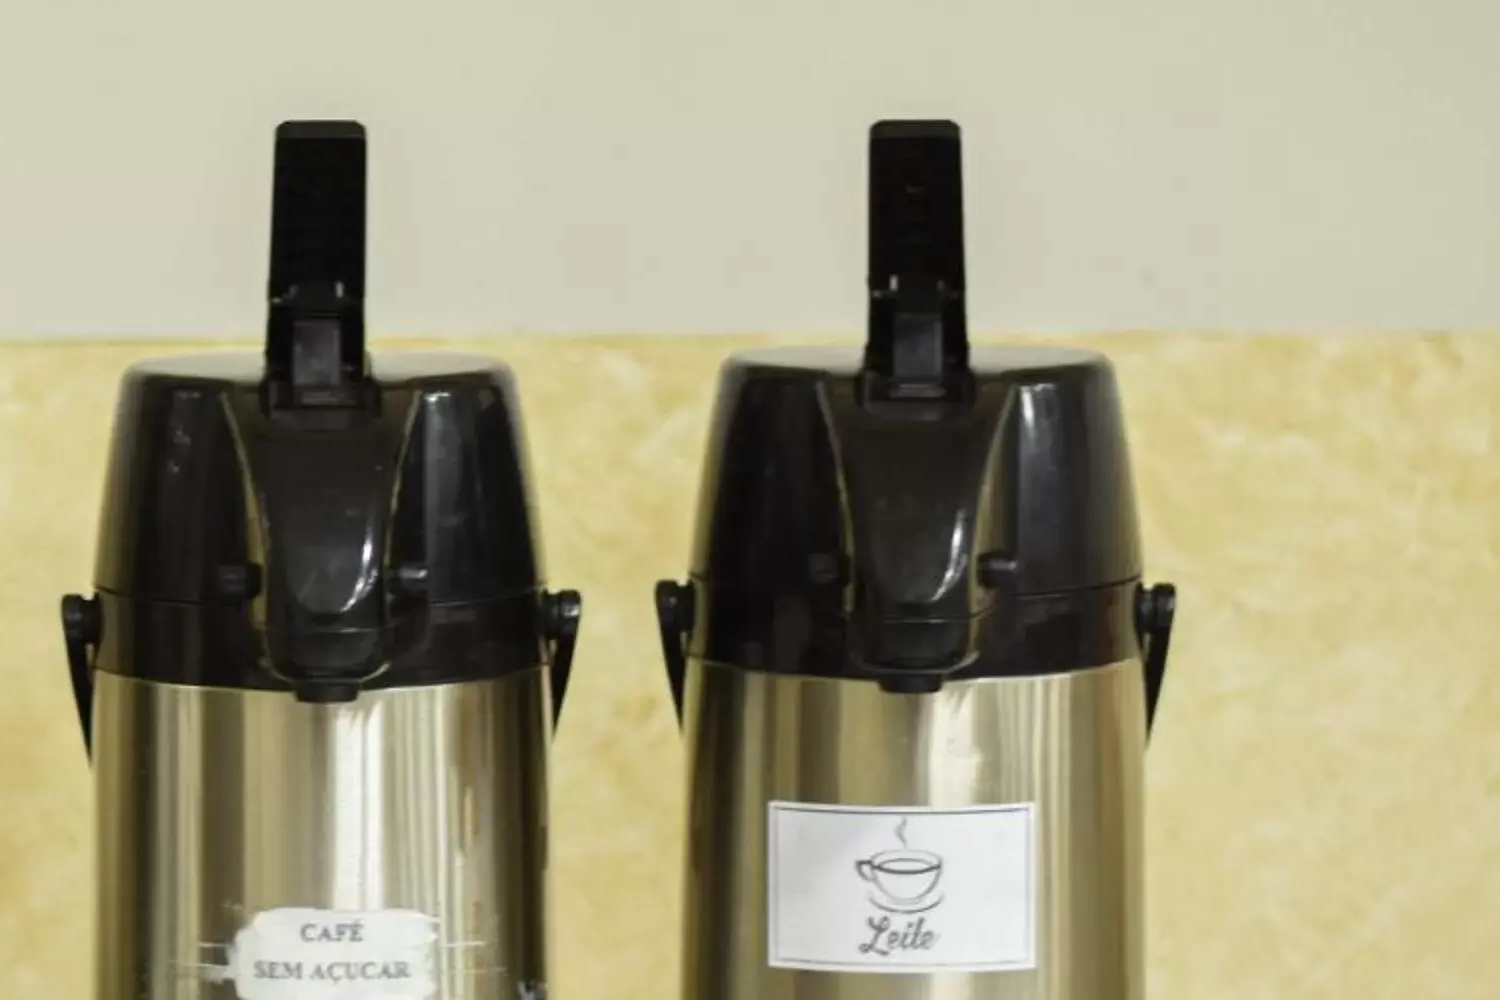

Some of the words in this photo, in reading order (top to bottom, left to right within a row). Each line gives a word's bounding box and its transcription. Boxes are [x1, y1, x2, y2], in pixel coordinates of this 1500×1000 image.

[300, 920, 365, 942] CAFÉ
[858, 916, 938, 956] Leite
[253, 962, 304, 979] SEM
